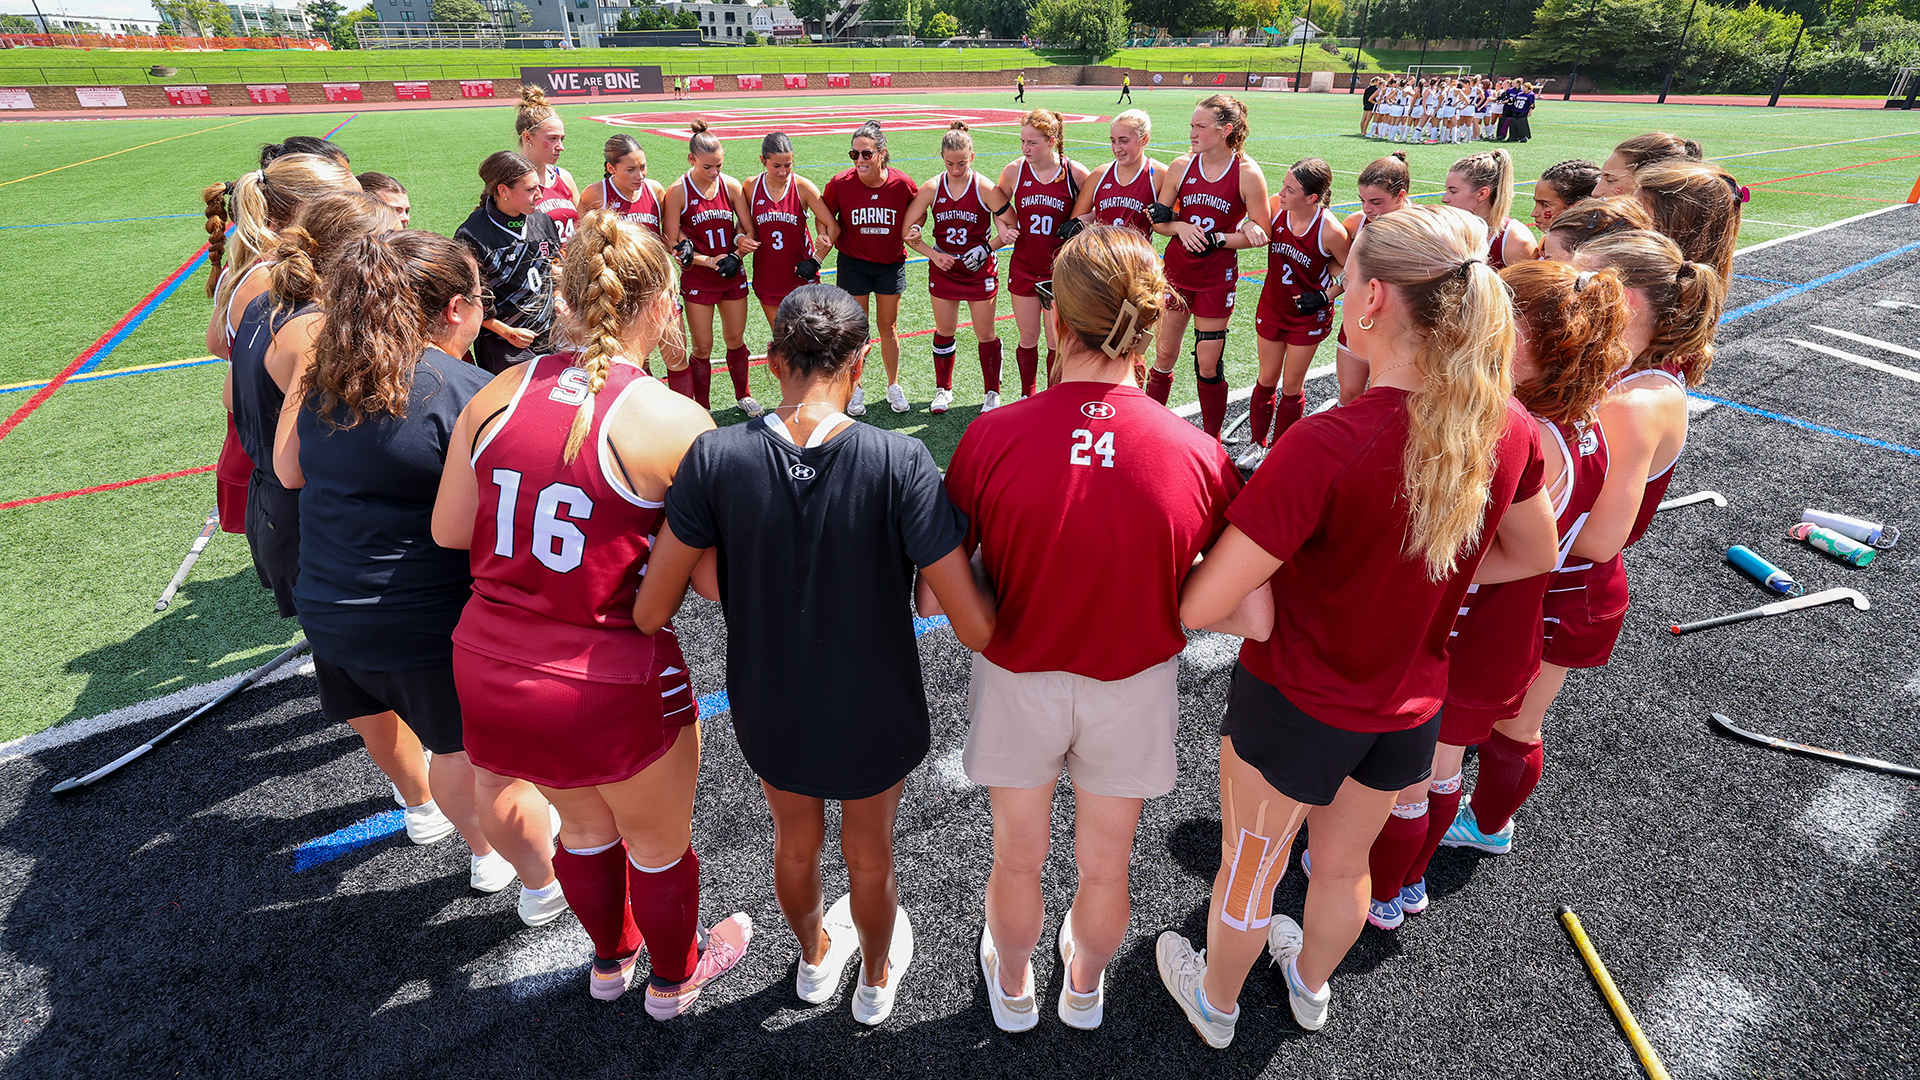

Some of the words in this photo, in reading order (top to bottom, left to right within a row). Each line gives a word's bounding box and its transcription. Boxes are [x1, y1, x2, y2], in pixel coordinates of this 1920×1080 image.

[547, 73, 581, 90] WE
[583, 77, 603, 86] ARE
[1020, 194, 1066, 212] SWARTHMORE
[1099, 196, 1144, 213] SWARTHMORE
[1183, 193, 1232, 214] SWARTHMORE
[617, 212, 659, 226] ARTHMORE
[691, 209, 733, 226] SWARTHMORE
[756, 211, 798, 225] SWARTHMORE
[851, 207, 898, 226] GARNET
[936, 210, 979, 224] SWARTHMORE
[1029, 214, 1054, 236] 20
[554, 218, 575, 243] 24
[705, 228, 727, 249] 11
[771, 230, 784, 250] 3
[945, 227, 968, 246] 23
[1271, 242, 1312, 269] SWARTHMORE
[527, 267, 543, 293] 0
[1281, 263, 1293, 285] 2
[548, 366, 590, 406] S
[1069, 428, 1116, 468] 24
[491, 468, 596, 575] 16
[652, 986, 694, 998] SALOMON
